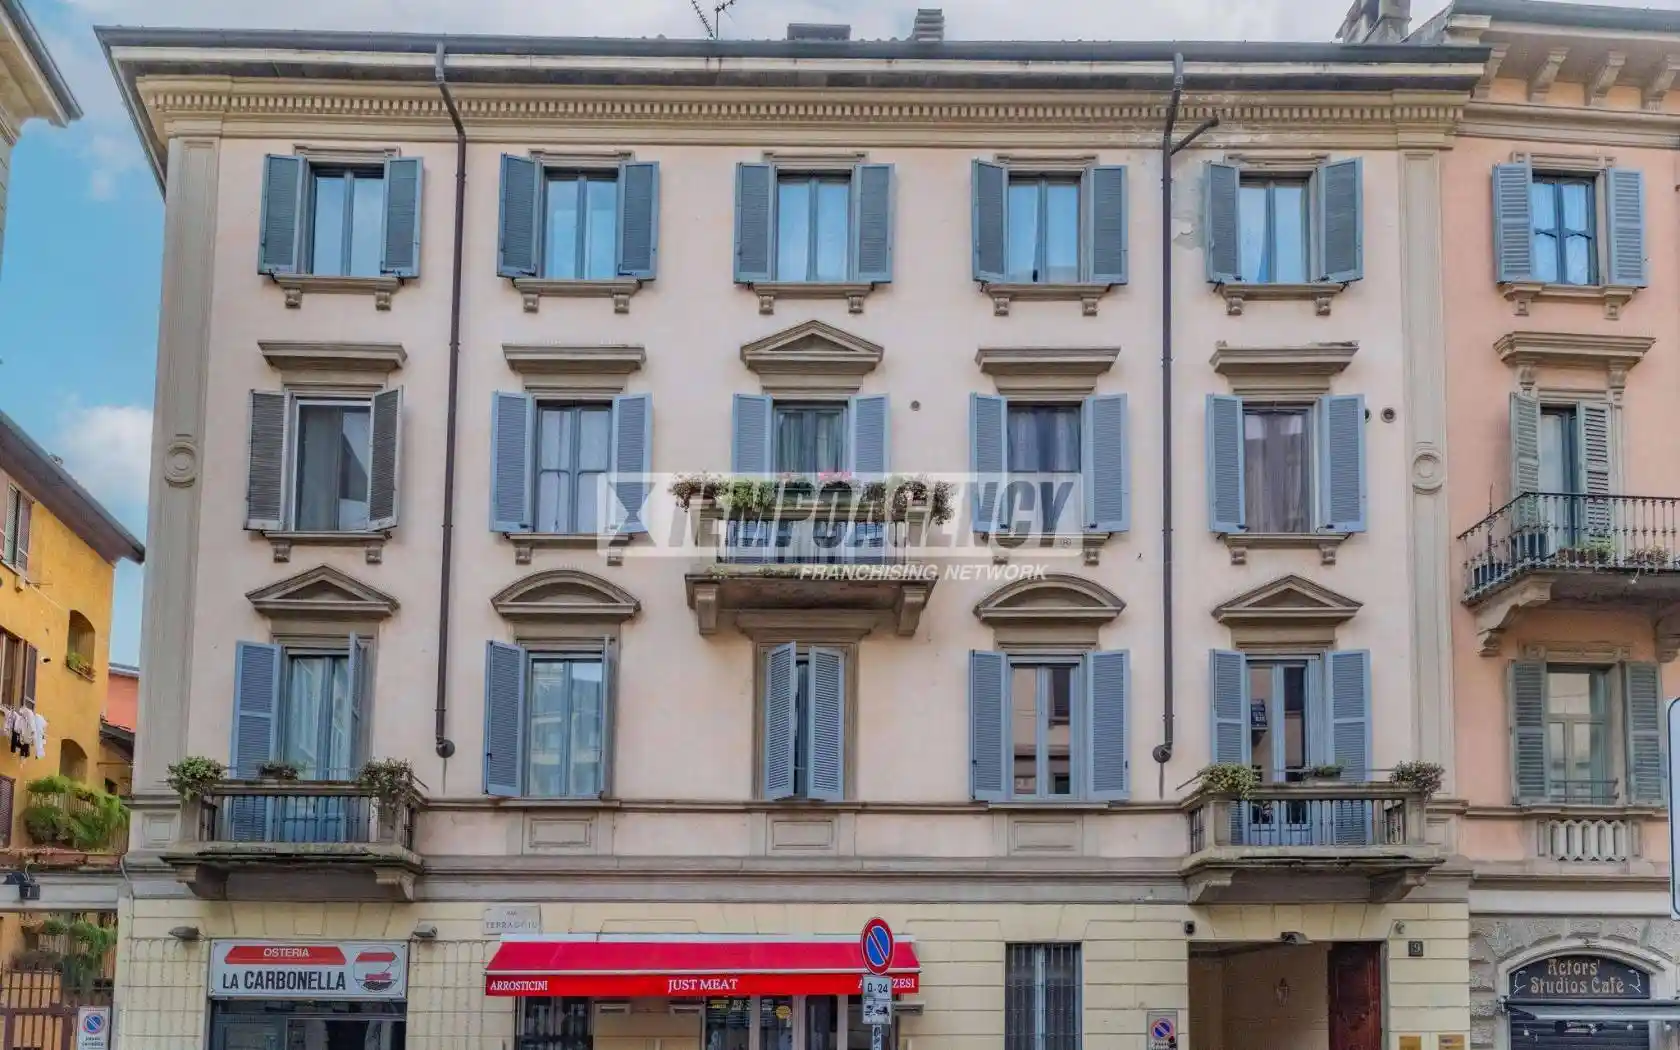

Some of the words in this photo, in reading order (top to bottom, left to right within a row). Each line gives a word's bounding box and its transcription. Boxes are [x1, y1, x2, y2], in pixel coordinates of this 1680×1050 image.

[263, 947, 310, 958] OSTERIA
[222, 973, 239, 989] LA
[244, 971, 346, 991] CARBONELLA
[490, 980, 548, 991] ARROSTICINI
[667, 979, 698, 994] JUST
[699, 978, 738, 990] MEAT
[1530, 977, 1588, 994] Studios
